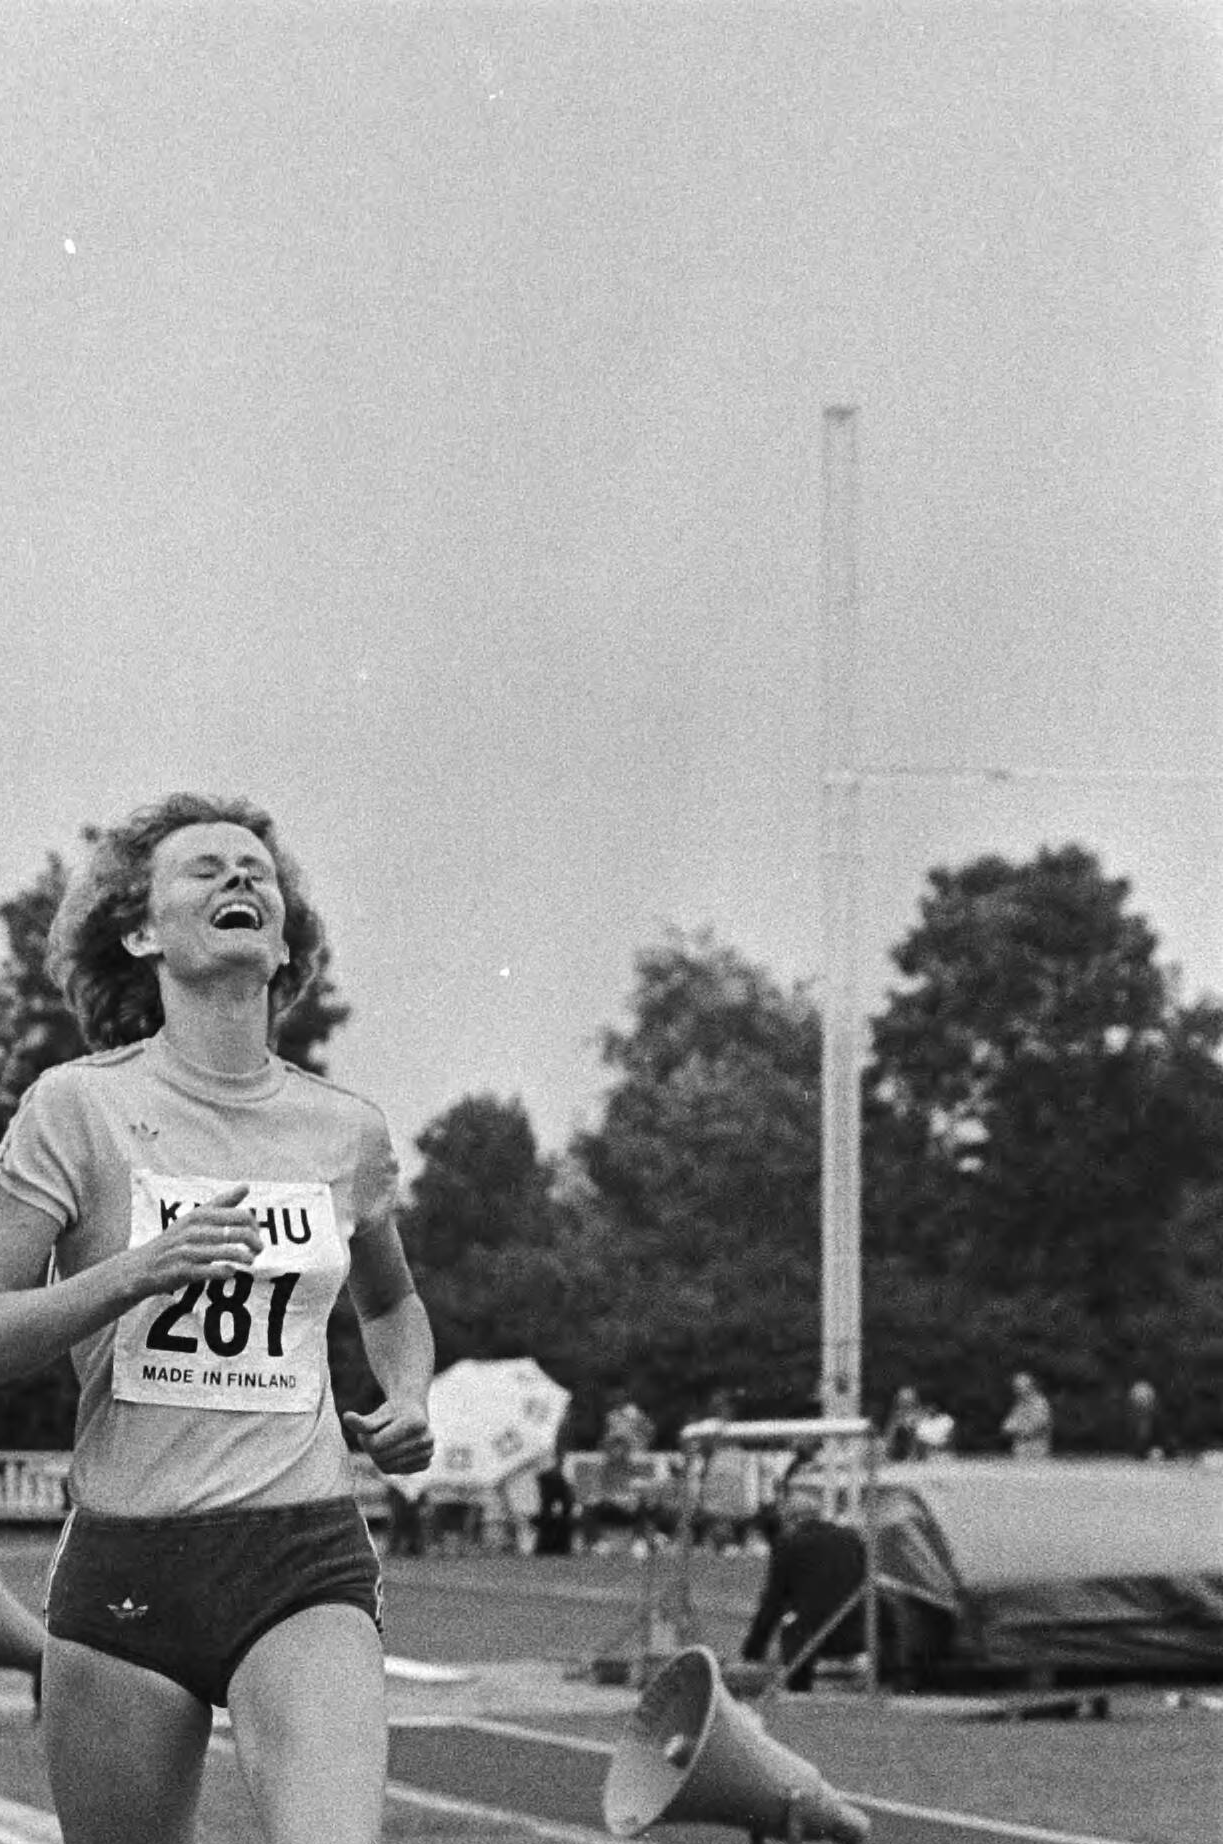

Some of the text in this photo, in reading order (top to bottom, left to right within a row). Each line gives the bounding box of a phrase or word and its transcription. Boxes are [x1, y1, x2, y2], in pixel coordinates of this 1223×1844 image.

[159, 1198, 312, 1246] KHU
[145, 1270, 301, 1358] 281
[142, 1364, 298, 1389] MADE IN FINLAND
